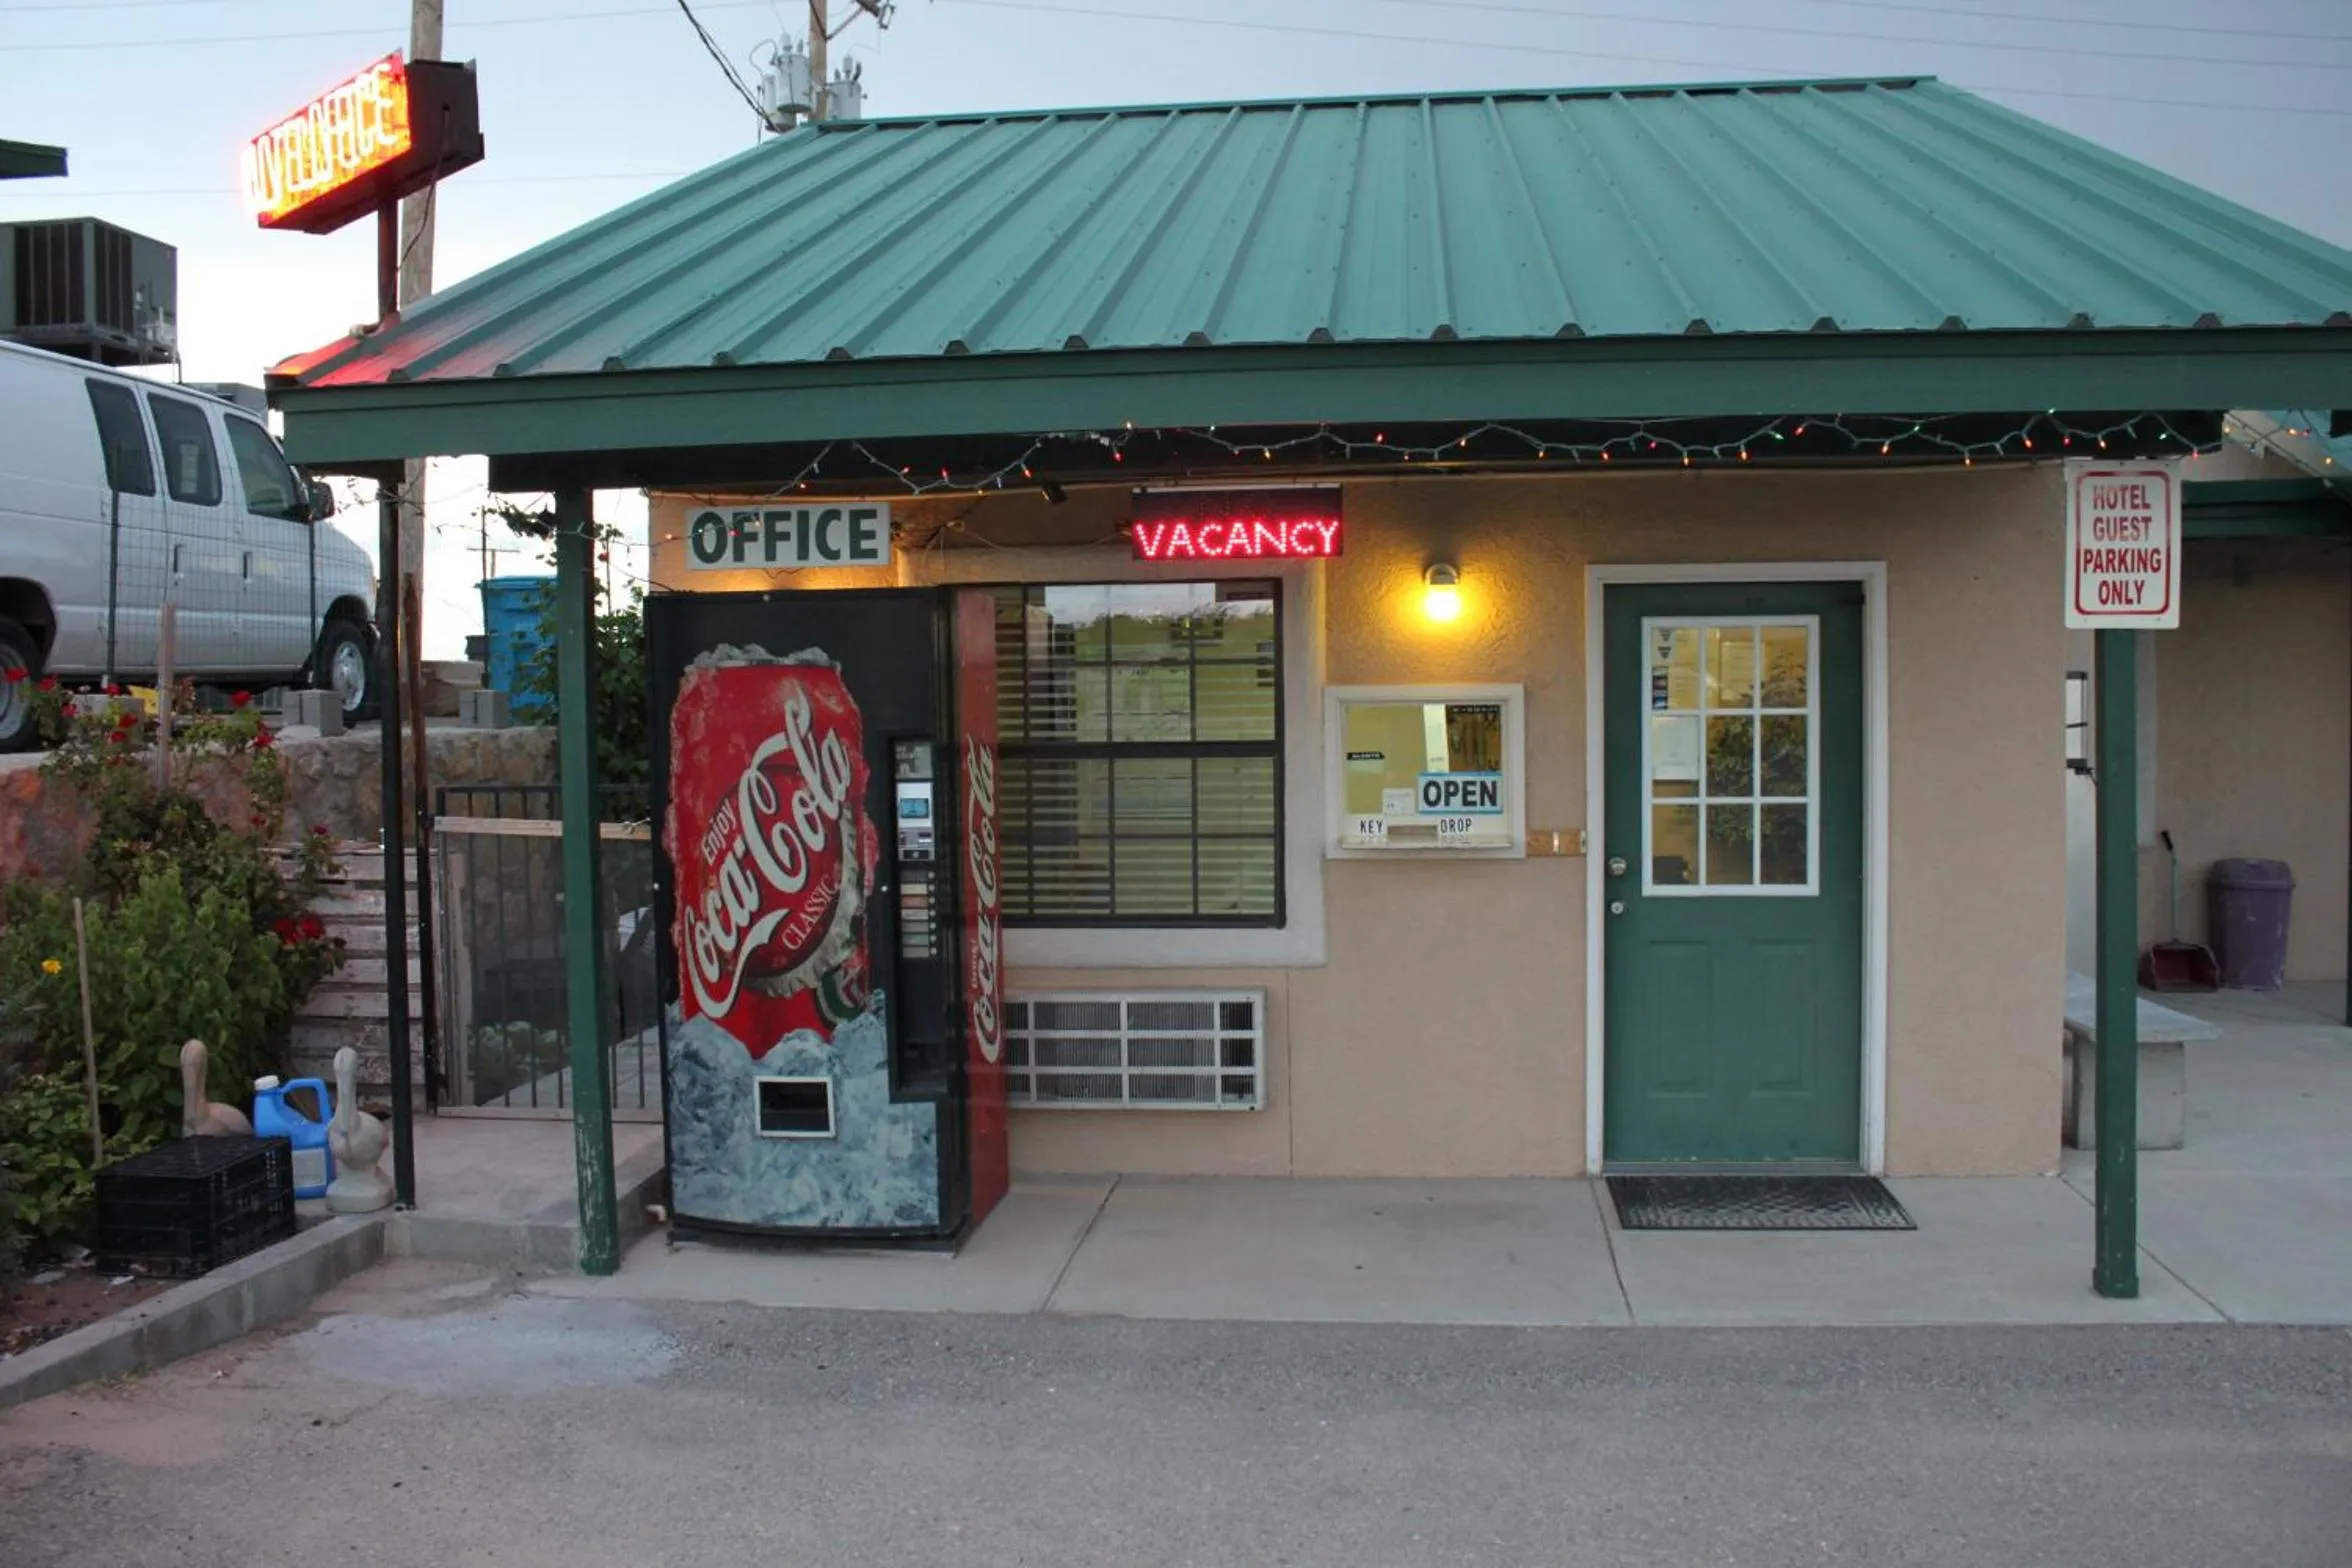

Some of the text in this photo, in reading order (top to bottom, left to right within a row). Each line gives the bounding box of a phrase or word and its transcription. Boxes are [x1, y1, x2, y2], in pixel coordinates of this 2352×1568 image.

[2092, 484, 2151, 510] HOTEL
[692, 508, 879, 564] OFFICE
[1134, 520, 1339, 557] VACANCY
[2092, 516, 2152, 541] GUEST
[2083, 547, 2162, 573] PARKING
[2098, 579, 2145, 605] ONLY
[1423, 780, 1498, 807] OPEN
[702, 798, 736, 866] Enjoy
[1360, 817, 1472, 834] KEY DROP
[684, 685, 850, 1019] Coca-Cola
[781, 874, 838, 950] CLASSIC
[968, 734, 1000, 1064] Coca-Cola
